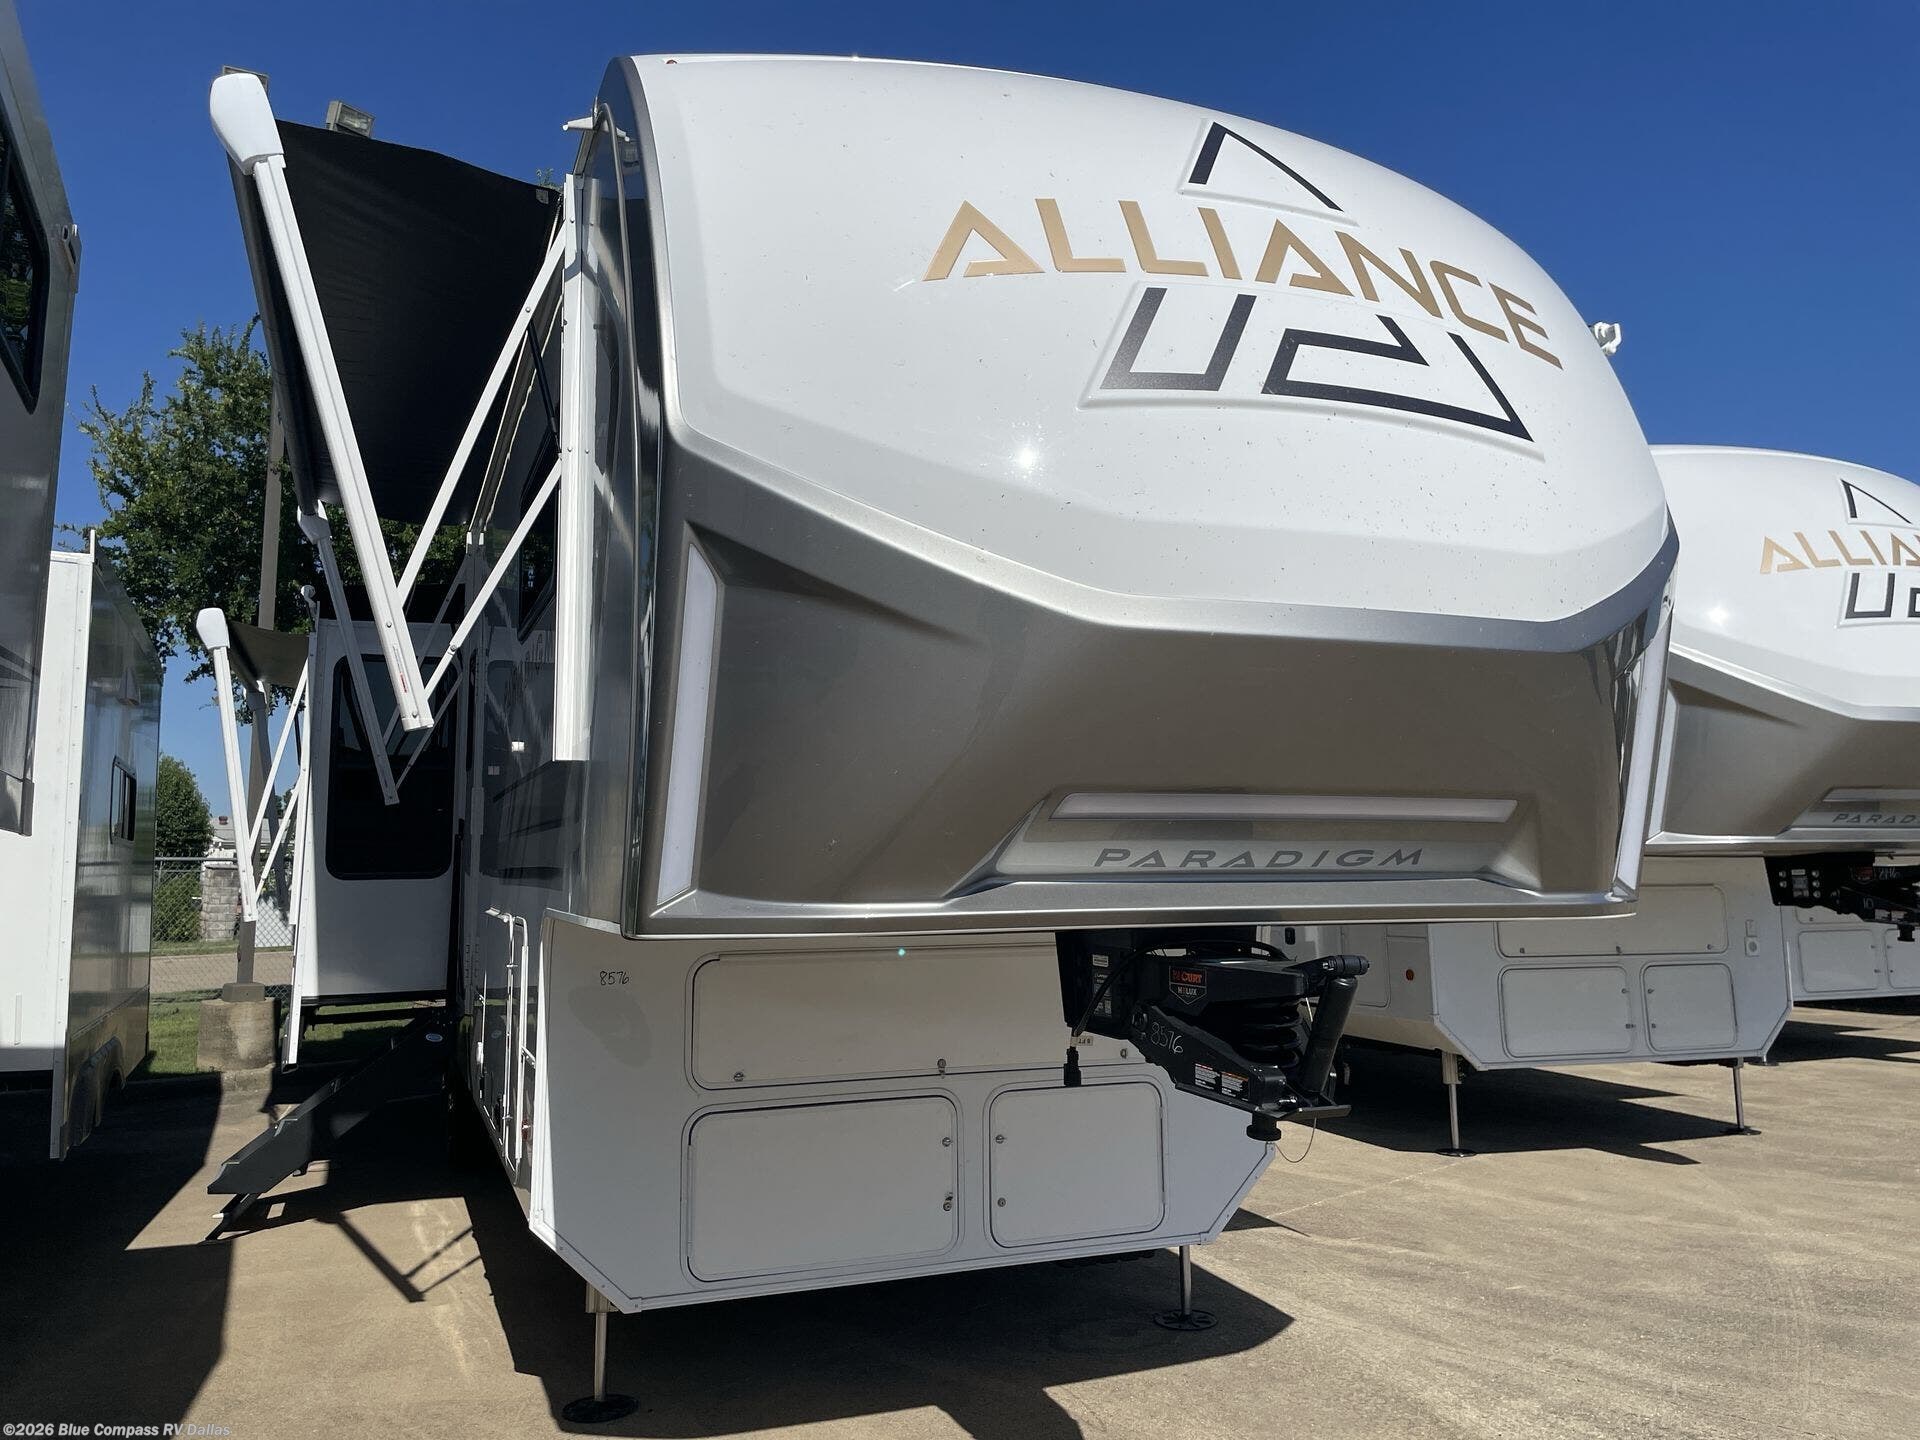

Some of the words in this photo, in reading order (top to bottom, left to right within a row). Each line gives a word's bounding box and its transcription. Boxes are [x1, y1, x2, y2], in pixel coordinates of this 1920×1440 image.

[923, 198, 1564, 370] ALLIANCE
[1760, 529, 1920, 574] ALLIA
[1832, 813, 1920, 824] PARAD
[1093, 848, 1423, 868] PARADIGM
[600, 970, 630, 986] 8576
[1182, 971, 1202, 984] CURT
[1150, 1021, 1184, 1054] 8576
